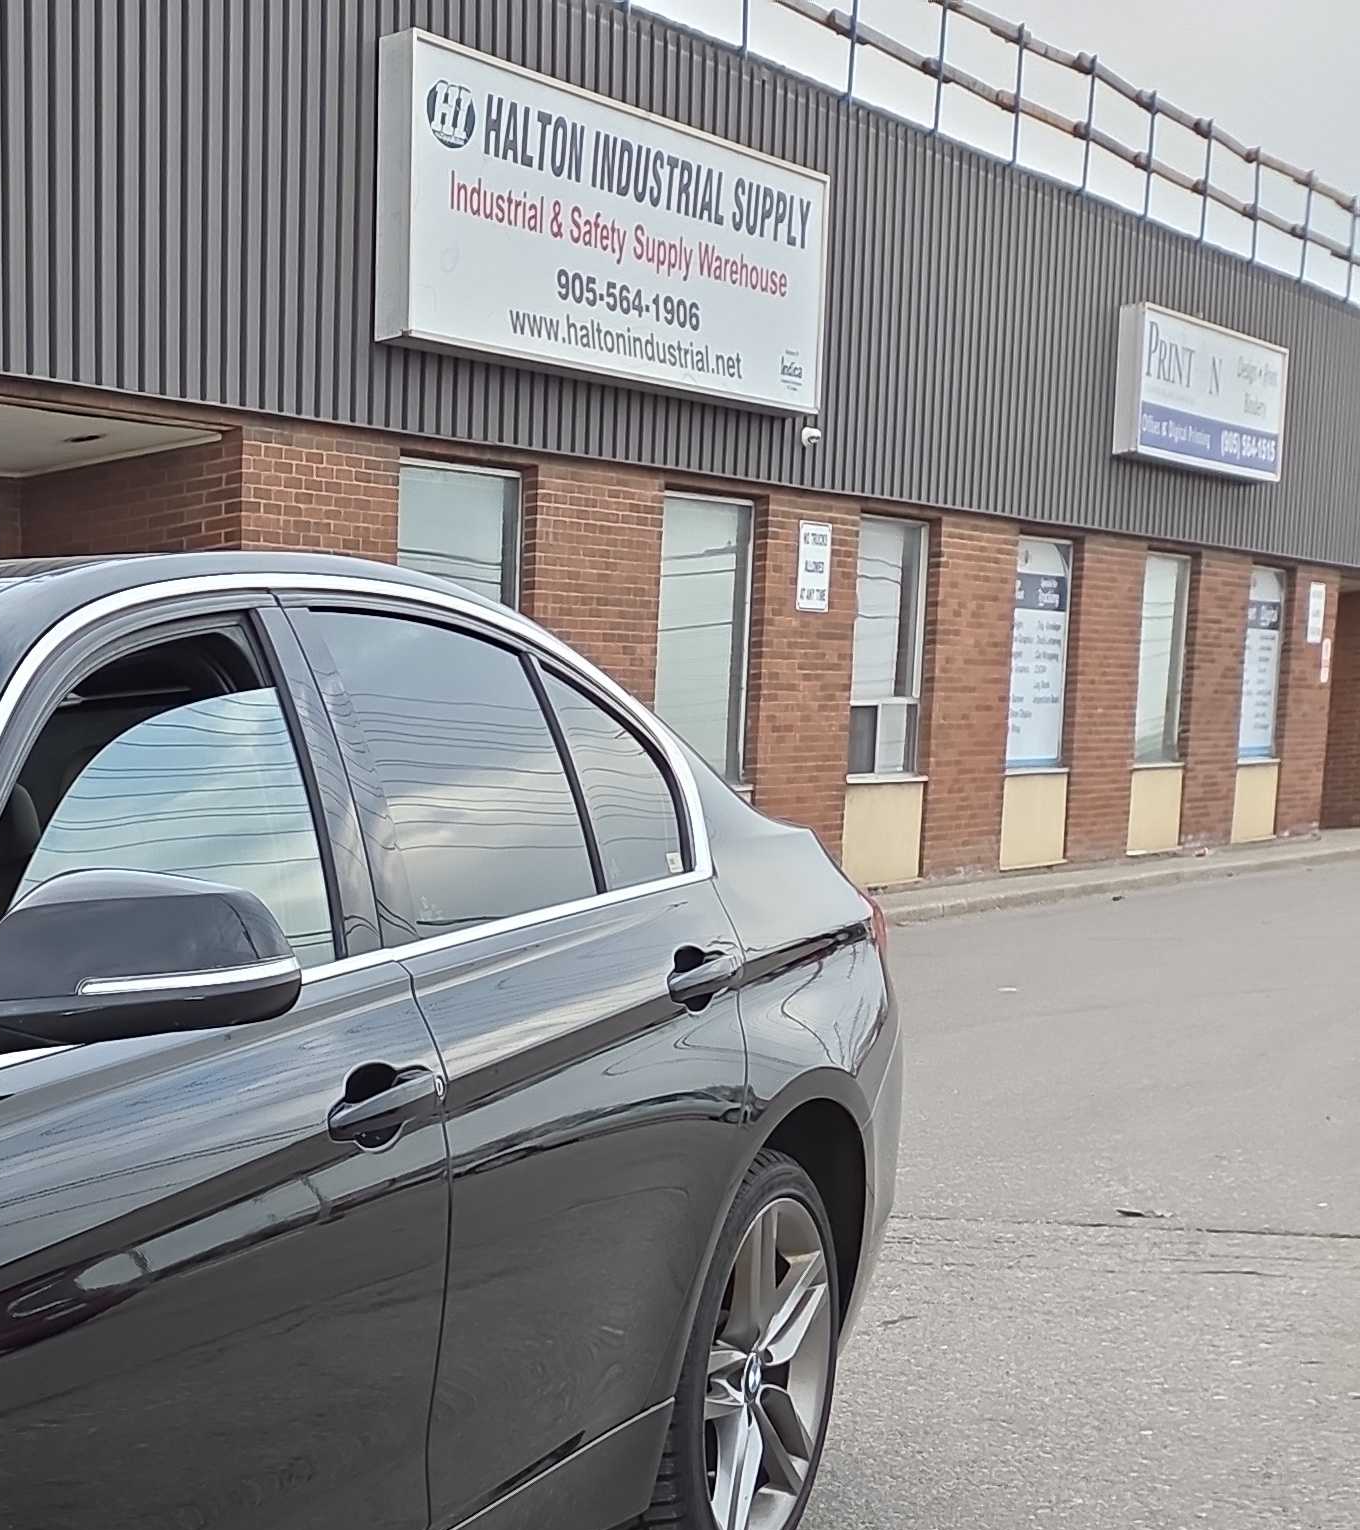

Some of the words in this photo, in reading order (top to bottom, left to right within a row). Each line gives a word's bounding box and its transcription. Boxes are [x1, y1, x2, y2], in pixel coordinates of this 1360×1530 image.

[483, 93, 587, 184] HALTON
[591, 131, 725, 227] INDUSTRIAL
[731, 177, 812, 250] SUPPLY
[449, 170, 544, 234] Industrial
[550, 199, 564, 239] &
[570, 205, 627, 266] Safety
[633, 224, 694, 282] Supply
[698, 241, 788, 297] Warehouse
[509, 307, 743, 380] www.haltonindustrial.net
[556, 269, 701, 332] 905-564-1906
